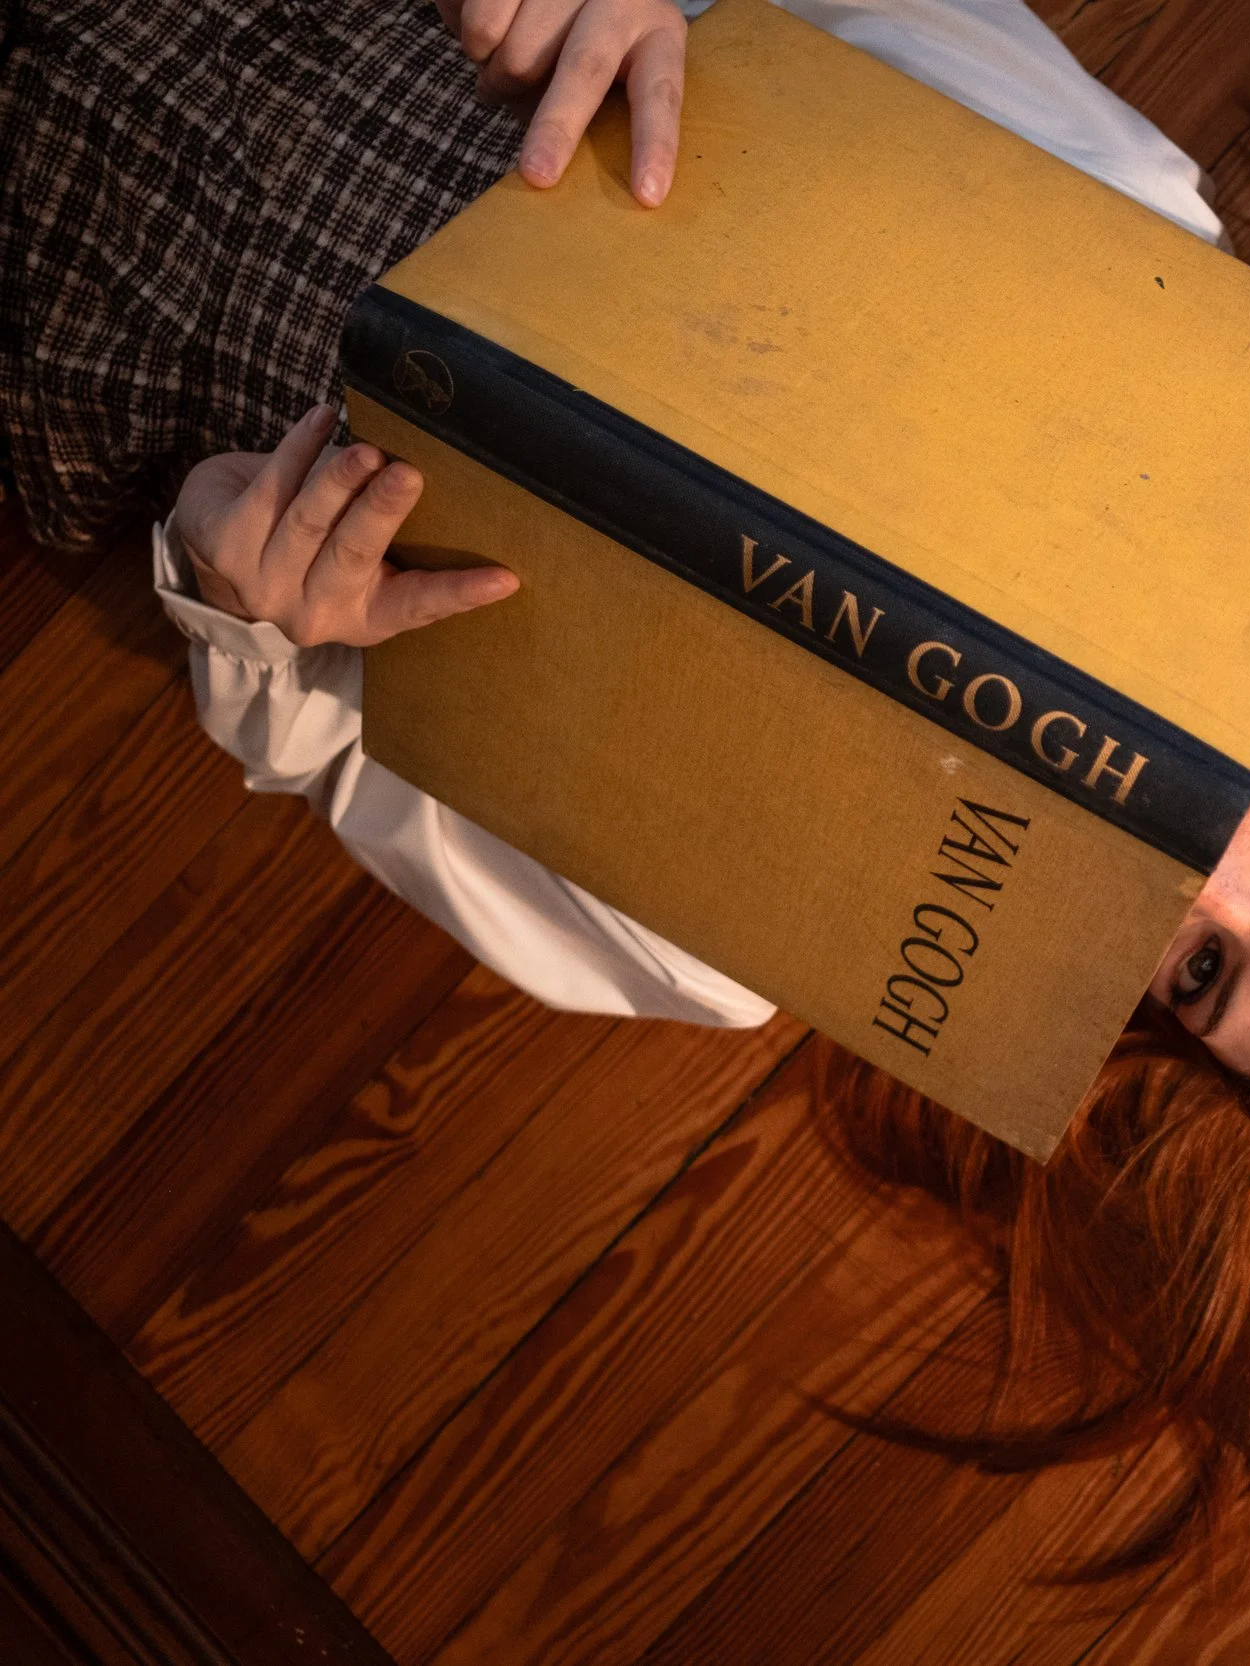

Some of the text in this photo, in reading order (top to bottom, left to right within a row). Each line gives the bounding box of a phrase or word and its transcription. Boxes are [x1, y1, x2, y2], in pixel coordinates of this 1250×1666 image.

[740, 533, 1151, 807] VAN GOGH
[871, 796, 1032, 1058] VAN GOGH
